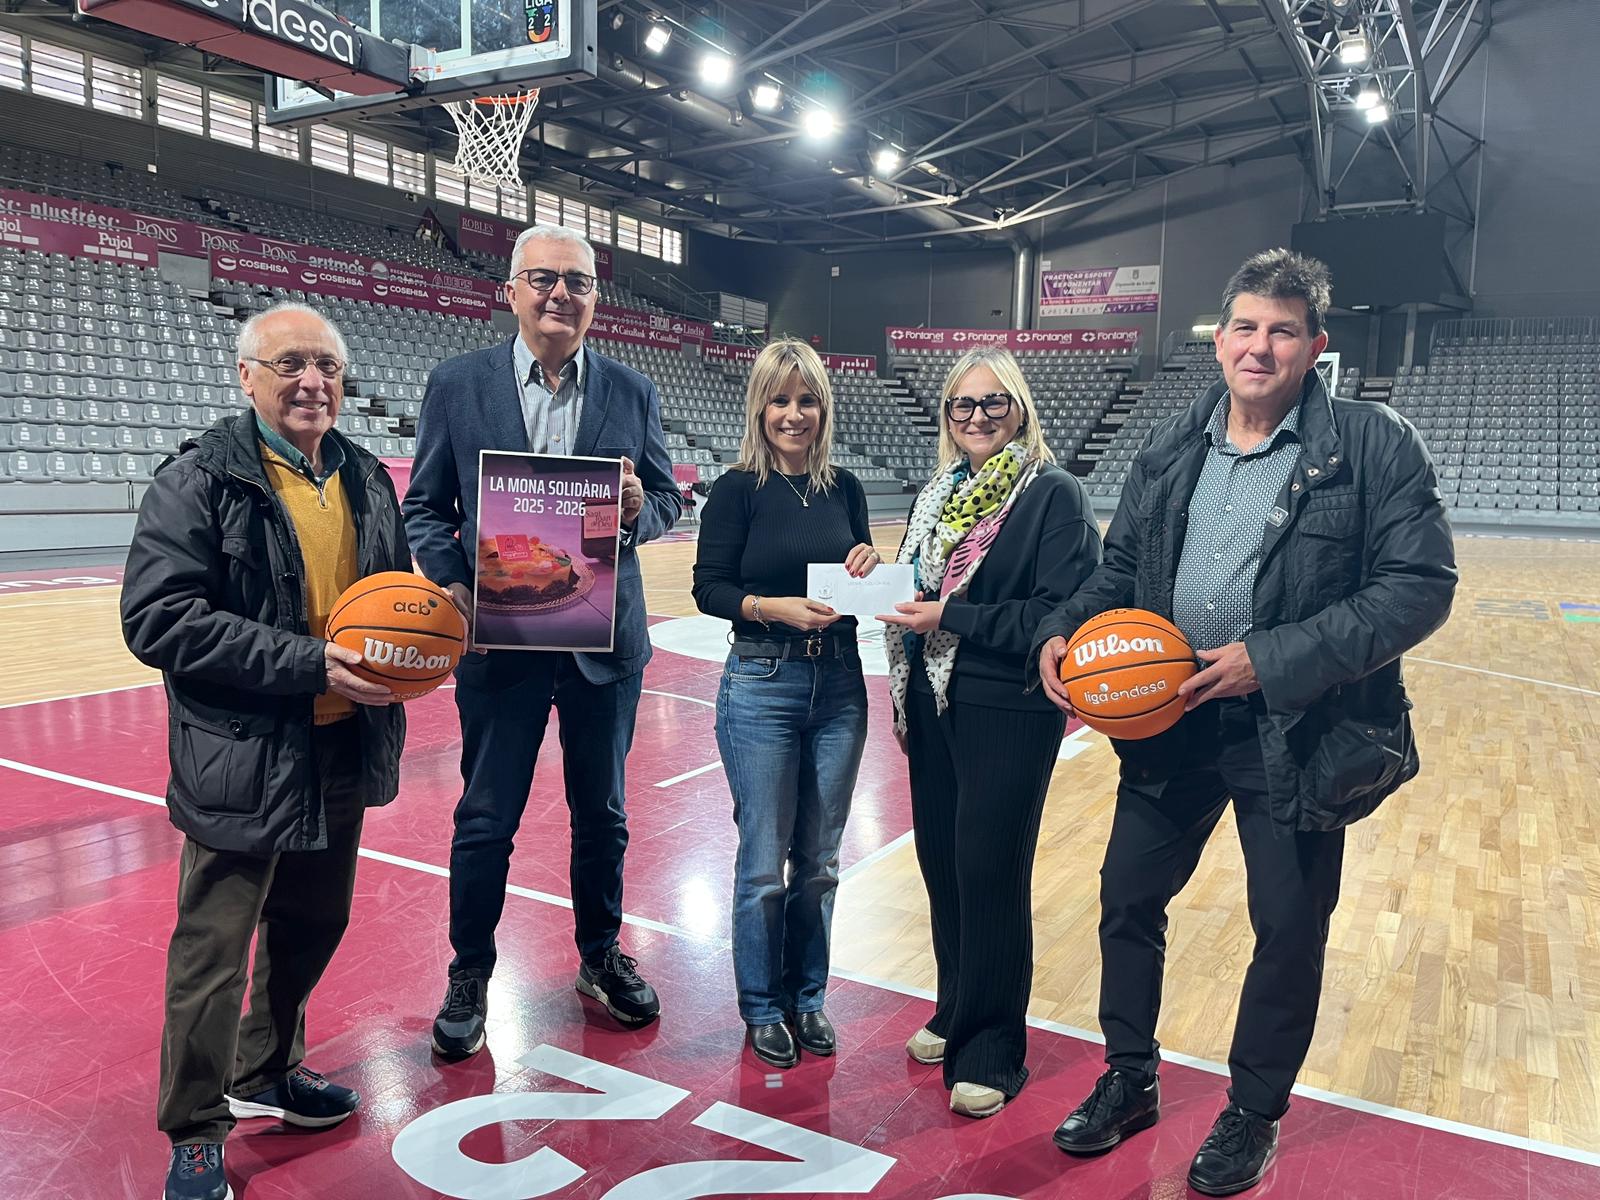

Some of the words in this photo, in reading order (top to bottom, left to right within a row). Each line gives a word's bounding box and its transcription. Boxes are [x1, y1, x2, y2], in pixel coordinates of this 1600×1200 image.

[202, 0, 353, 65] desa
[136, 220, 178, 242] PONS
[462, 217, 494, 233] ROBLES
[98, 232, 133, 250] Pujol
[200, 231, 240, 254] PONS
[262, 243, 297, 264] PONS
[239, 258, 289, 275] COSEHISA
[1084, 271, 1112, 279] ESPORT
[319, 273, 364, 288] COSEHISA
[389, 285, 429, 299] COSEHISA
[452, 296, 487, 309] COSEHISA
[905, 331, 944, 341] Fontanet
[967, 332, 1007, 342] Fontanet
[1032, 333, 1072, 342] Fontanet
[1097, 331, 1138, 340] Fontanet
[489, 476, 505, 492] LA
[507, 477, 545, 495] MONA
[548, 478, 611, 499] SOLIDÀRIA
[513, 497, 544, 514] 2025
[555, 500, 586, 517] 2026
[393, 601, 431, 616] acb
[364, 637, 451, 669] Wilson
[1073, 633, 1165, 667] Wilson
[1084, 690, 1108, 705] liga
[1110, 679, 1167, 701] endesa
